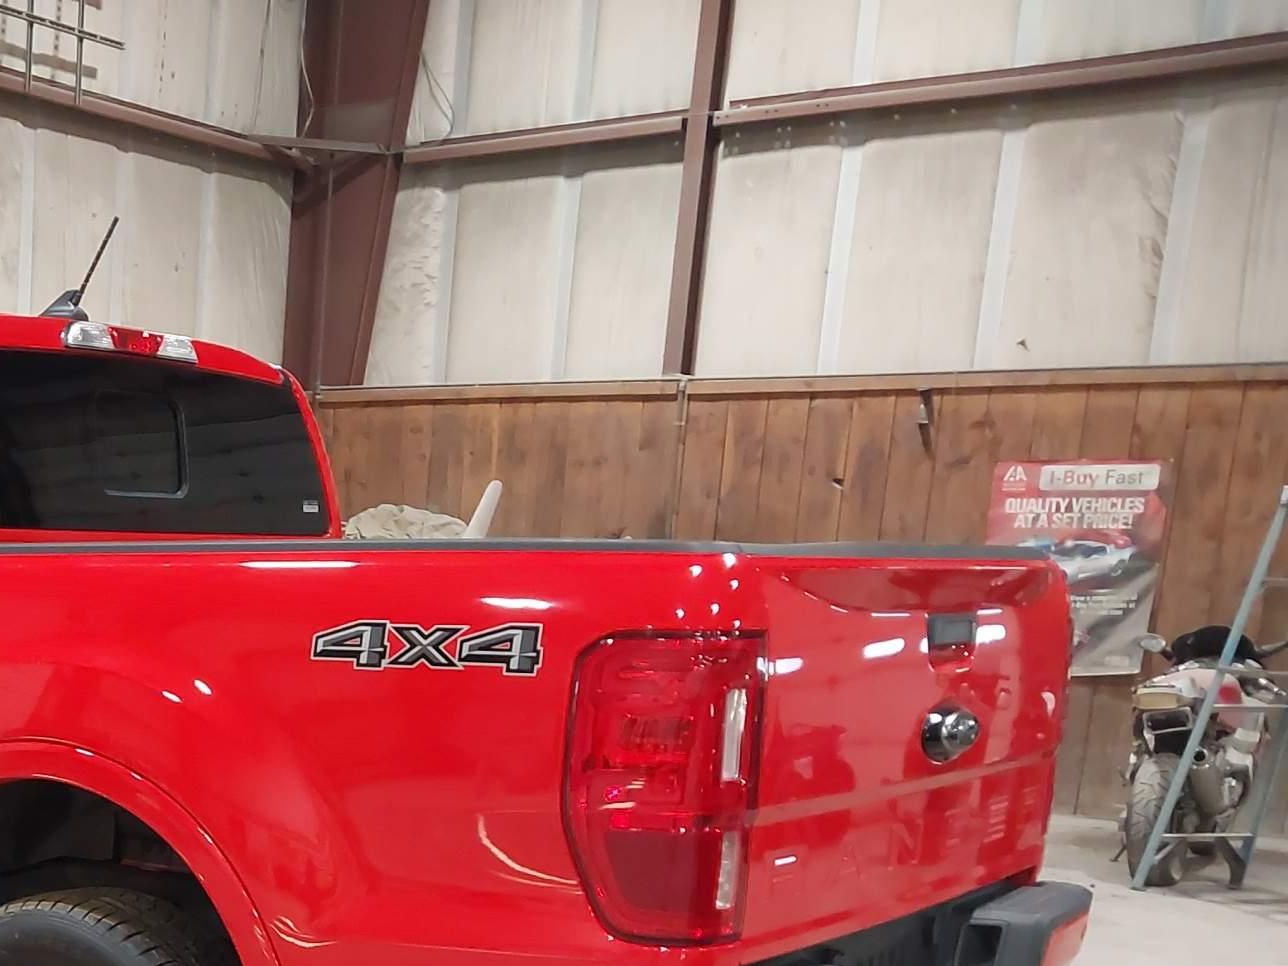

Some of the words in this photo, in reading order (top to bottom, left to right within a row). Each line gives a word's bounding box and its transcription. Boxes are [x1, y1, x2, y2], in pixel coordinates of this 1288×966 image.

[1050, 470, 1100, 487] I-Buy
[1105, 469, 1145, 485] Fast
[1005, 497, 1071, 514] QUALITY
[1072, 496, 1146, 513] VEHICLES
[1014, 513, 1035, 529] AT
[1035, 513, 1048, 528] A
[1051, 513, 1081, 529] SET
[1082, 513, 1134, 529] PRICE!
